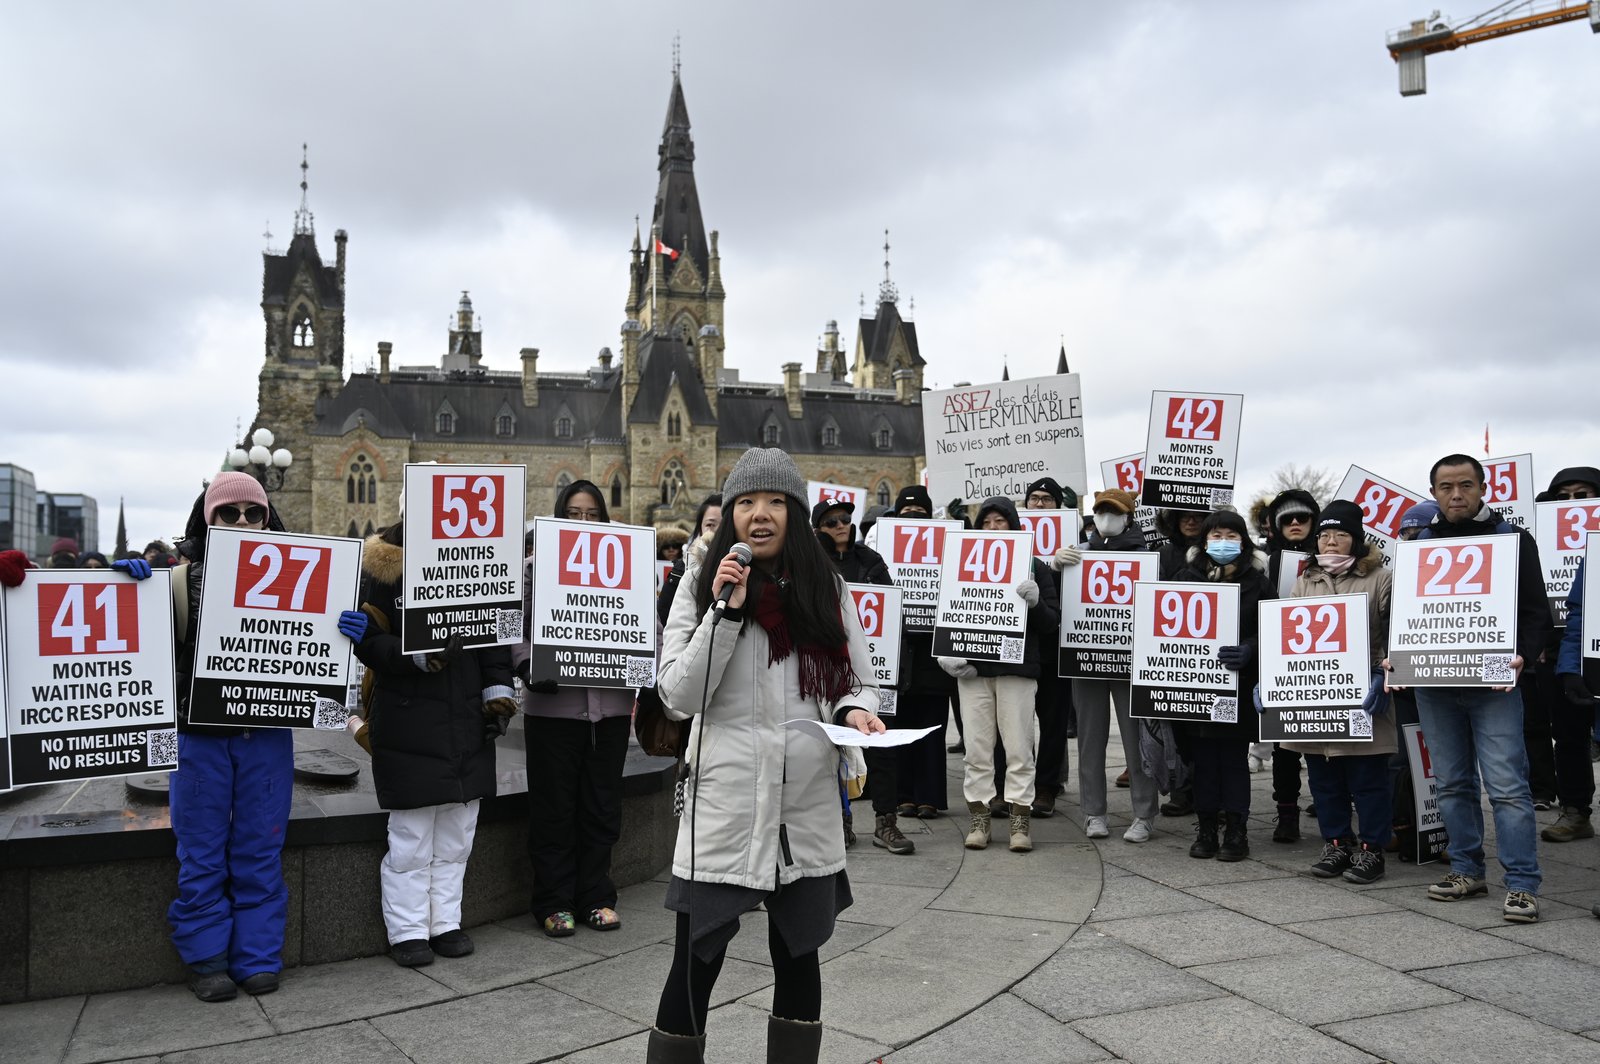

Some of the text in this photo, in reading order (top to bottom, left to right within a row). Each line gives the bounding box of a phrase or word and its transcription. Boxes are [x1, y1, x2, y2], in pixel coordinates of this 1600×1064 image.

[942, 384, 1058, 415] ASSEZ des délais
[944, 396, 1082, 434] INTERMINABLE
[1172, 398, 1216, 439] 42
[936, 426, 1083, 454] Nos vies sont en suspens.
[1170, 443, 1213, 455] MONTHS
[1158, 454, 1224, 468] WAITING FOR
[964, 460, 1049, 479] Transparence.
[1121, 458, 1144, 492] 3
[1150, 466, 1229, 480] IRCC RESPONSE
[964, 478, 1001, 500] Délais
[1158, 483, 1211, 495] NO TIMELINE
[1162, 494, 1174, 502] NO
[440, 476, 496, 537] 53
[1359, 484, 1405, 536] 81
[1564, 506, 1600, 549] 3
[900, 527, 938, 564] 71
[438, 546, 494, 562] MONTHS
[566, 532, 624, 588] 40
[964, 540, 1008, 582] 40
[244, 544, 321, 610] 27
[422, 563, 508, 581] WAITING FOR
[897, 568, 938, 578] MONTHS
[1424, 545, 1484, 595] 22
[1088, 561, 1132, 604] 65
[413, 581, 515, 601] IRCC RESPONSE
[961, 587, 1004, 599] MONTHS
[566, 593, 624, 609] MONTHS
[950, 600, 1014, 613] WAITING FOR
[1422, 601, 1482, 614] MONTHS
[51, 584, 127, 653] 41
[427, 612, 443, 625] NO
[551, 609, 639, 626] WAITING FOR
[859, 592, 879, 636] 6
[942, 612, 1019, 626] IRCC RESPONSE
[1085, 608, 1131, 619] MONTHS
[1161, 592, 1211, 638] 90
[240, 618, 314, 636] MONTHS
[1074, 620, 1118, 632] WAITING
[1287, 604, 1340, 653] 32
[1407, 616, 1497, 629] WAITING FOR
[432, 627, 448, 640] NO
[542, 626, 647, 644] IRCC RESPONSE
[950, 632, 1006, 643] NO TIMELINE
[1066, 633, 1090, 643] IRCC
[1398, 631, 1505, 644] IRCC RESPONSE
[220, 636, 331, 657] WAITING FOR
[952, 642, 964, 651] NO
[1160, 643, 1210, 655] MONTHS
[555, 651, 632, 666] NO TIMELINE
[872, 656, 886, 666] OR
[1076, 652, 1131, 662] NO TIMELINE
[1147, 656, 1222, 670] WAITING FOR
[1410, 654, 1482, 665] NO TIMELINE
[53, 660, 132, 679] MONTHS
[206, 656, 245, 672] IRCC
[248, 658, 339, 678] RESPONSE
[560, 665, 627, 679] NO RESULTS
[1080, 663, 1093, 672] NO
[1287, 659, 1339, 672] MONTHS
[1414, 666, 1482, 677] NO RESULTS
[1139, 670, 1230, 684] IRCC RESPONSE
[1275, 673, 1354, 687] WAITING FOR
[32, 680, 153, 702] WAITING FOR
[221, 685, 319, 702] NO TIMELINES
[1150, 690, 1217, 702] NO TIMELINES
[1268, 688, 1362, 701] IRCC RESPONSE
[21, 700, 164, 725] IRCC RESPONSE
[226, 702, 311, 719] NO RESULTS
[1154, 702, 1212, 714] NO RESULTS
[1280, 710, 1349, 721] NO TIMELINES
[1284, 722, 1345, 733] NO RESULTS
[41, 731, 147, 753] NO TIMELINES
[49, 749, 141, 770] NO RESULTS
